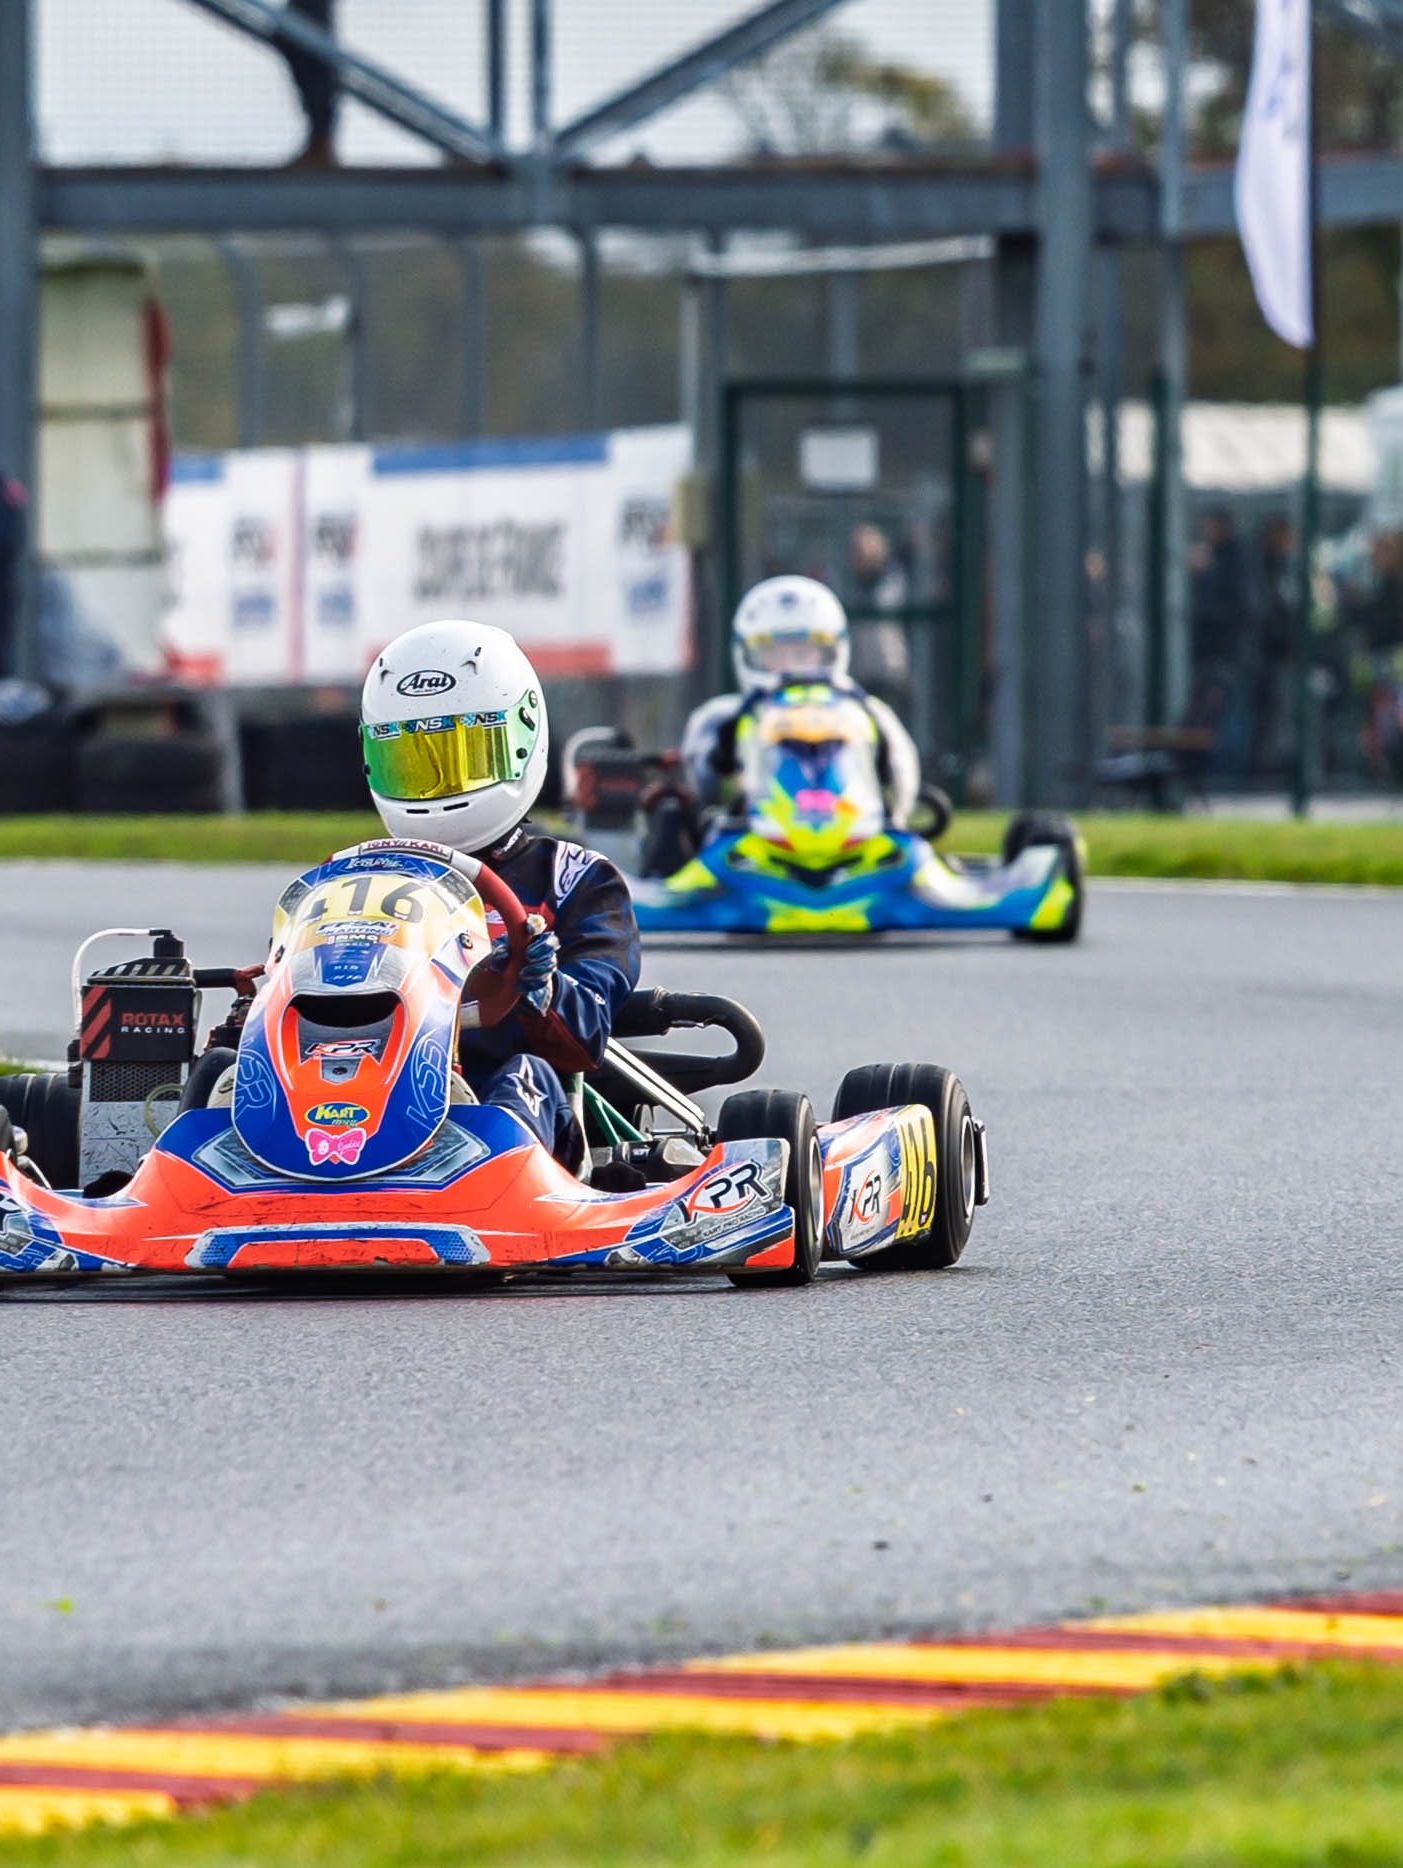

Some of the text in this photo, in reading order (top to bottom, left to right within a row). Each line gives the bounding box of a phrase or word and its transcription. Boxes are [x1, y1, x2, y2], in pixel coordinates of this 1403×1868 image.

[401, 673, 448, 690] Arai
[373, 711, 507, 737] NSK NSK NSK
[121, 1012, 185, 1026] ROTAX
[121, 1026, 185, 1034] RACING
[674, 1162, 770, 1224] KPR
